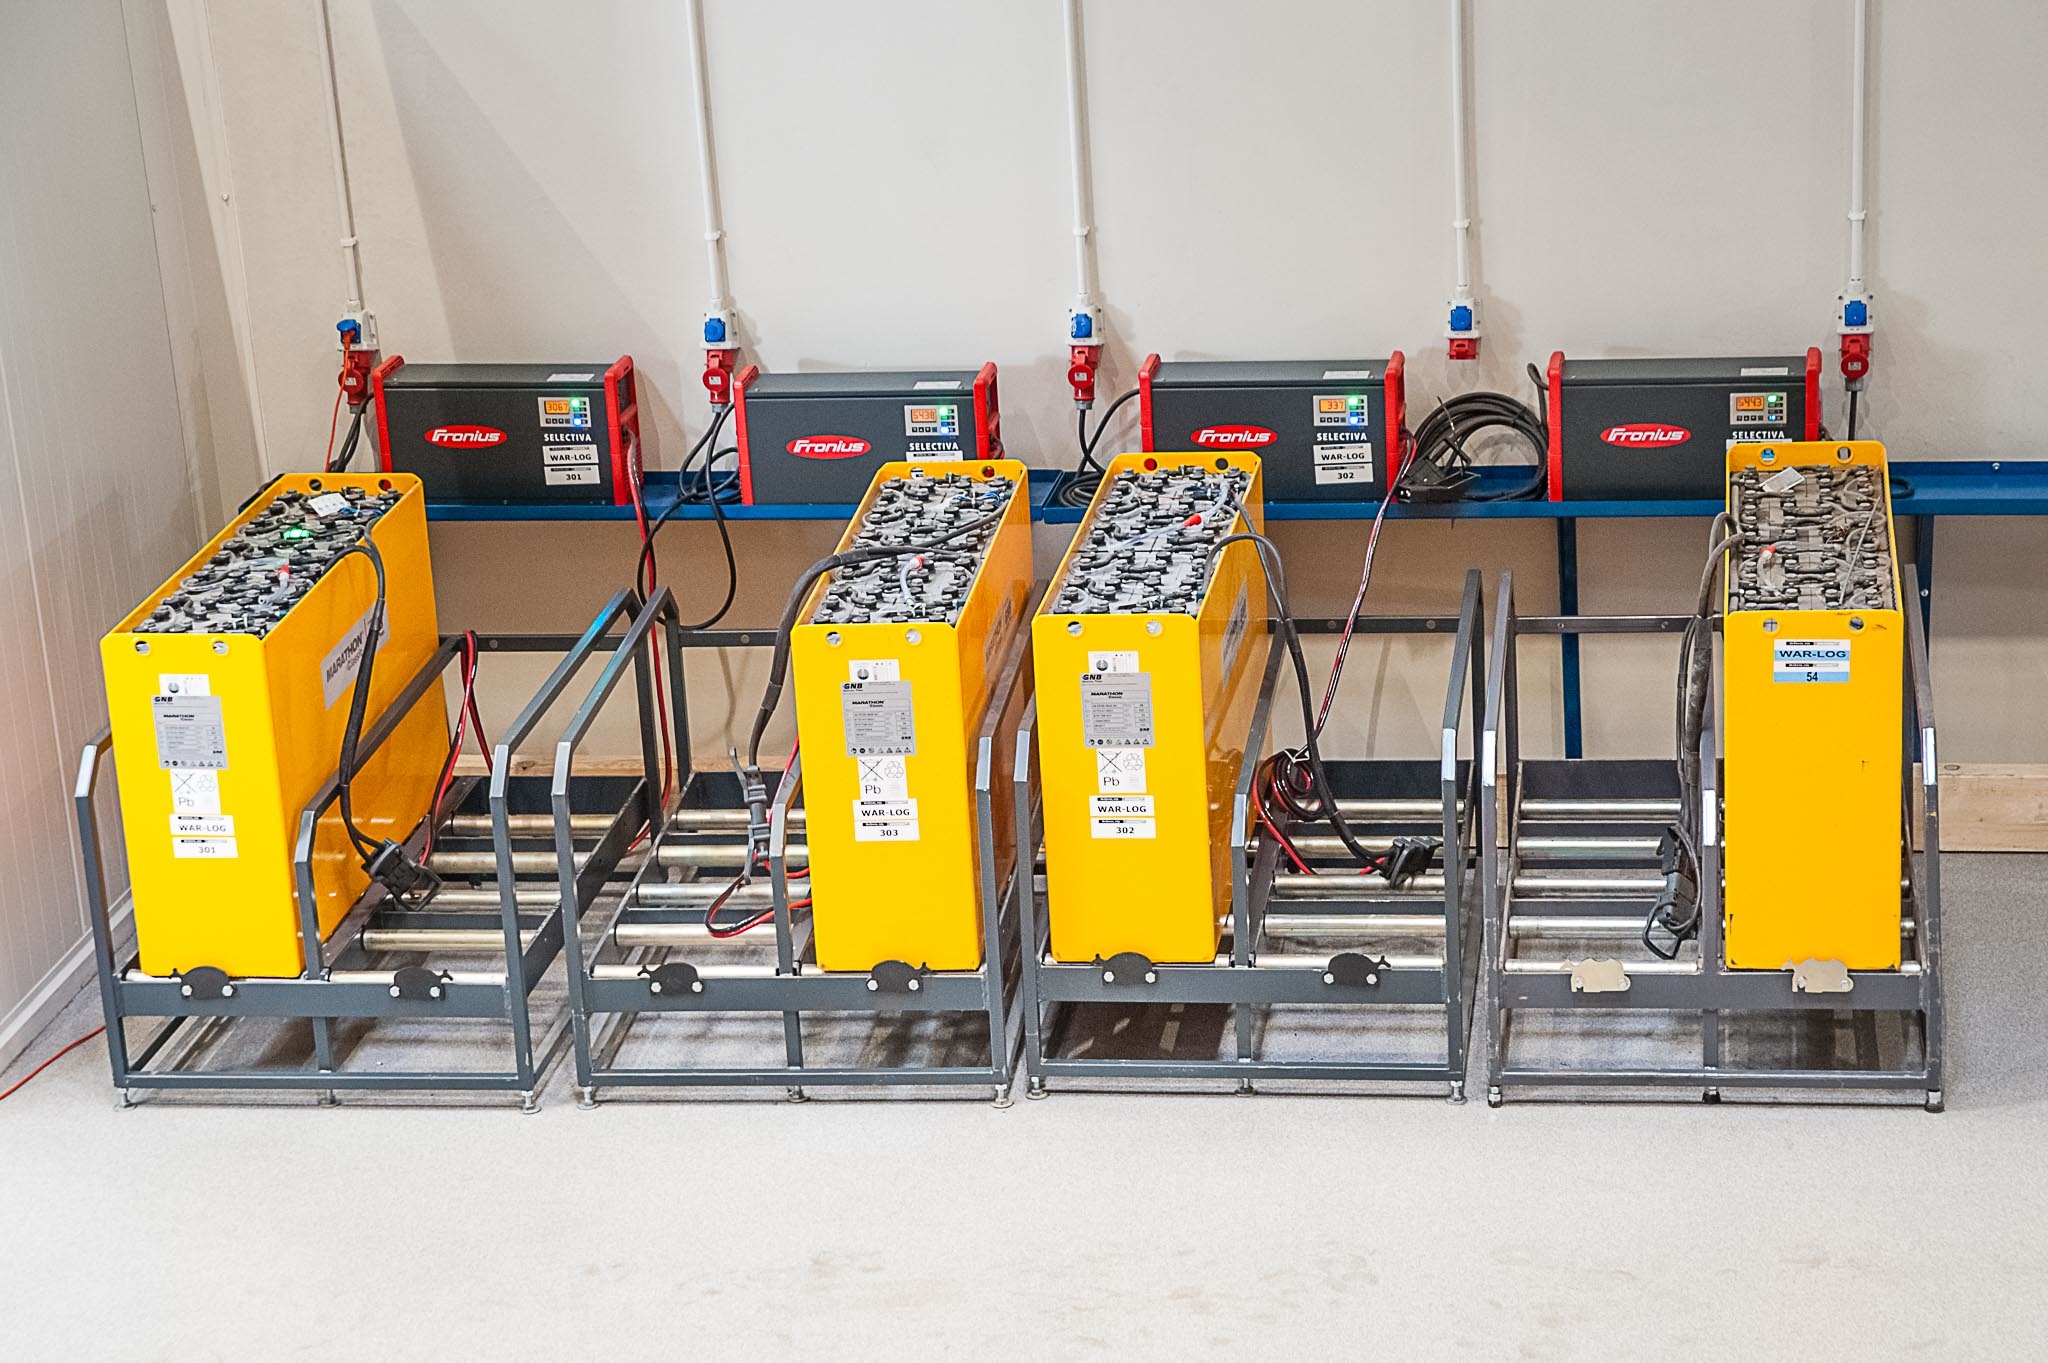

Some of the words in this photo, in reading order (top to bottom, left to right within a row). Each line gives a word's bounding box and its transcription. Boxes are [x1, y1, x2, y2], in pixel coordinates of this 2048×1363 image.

[430, 428, 501, 443] Fronius
[543, 433, 592, 442] SELECTIVA
[1197, 429, 1271, 443] Fronius
[1316, 432, 1368, 441] SELECTIVA
[1607, 427, 1685, 442] Fronius
[1732, 430, 1785, 439] SELECTIVA
[792, 439, 865, 453] Fronius
[909, 442, 959, 451] SELECTIVA
[550, 454, 592, 462] WAR-LOG
[1321, 452, 1365, 461] WAR-LOG
[565, 473, 582, 481] 301
[1337, 472, 1354, 480] 302
[325, 632, 364, 683] MARATHON
[1779, 650, 1846, 658] WAR-LOG
[1806, 672, 1818, 682] 54
[1103, 777, 1120, 787] Pb
[865, 785, 881, 794] Pb
[178, 796, 194, 807] Pb
[861, 809, 910, 817] WAR-LOG
[1097, 805, 1147, 813] WAR-LOG
[179, 824, 227, 832] WAR-LOG
[1116, 826, 1134, 834] 302
[880, 829, 898, 837] 303
[199, 846, 216, 854] 301
